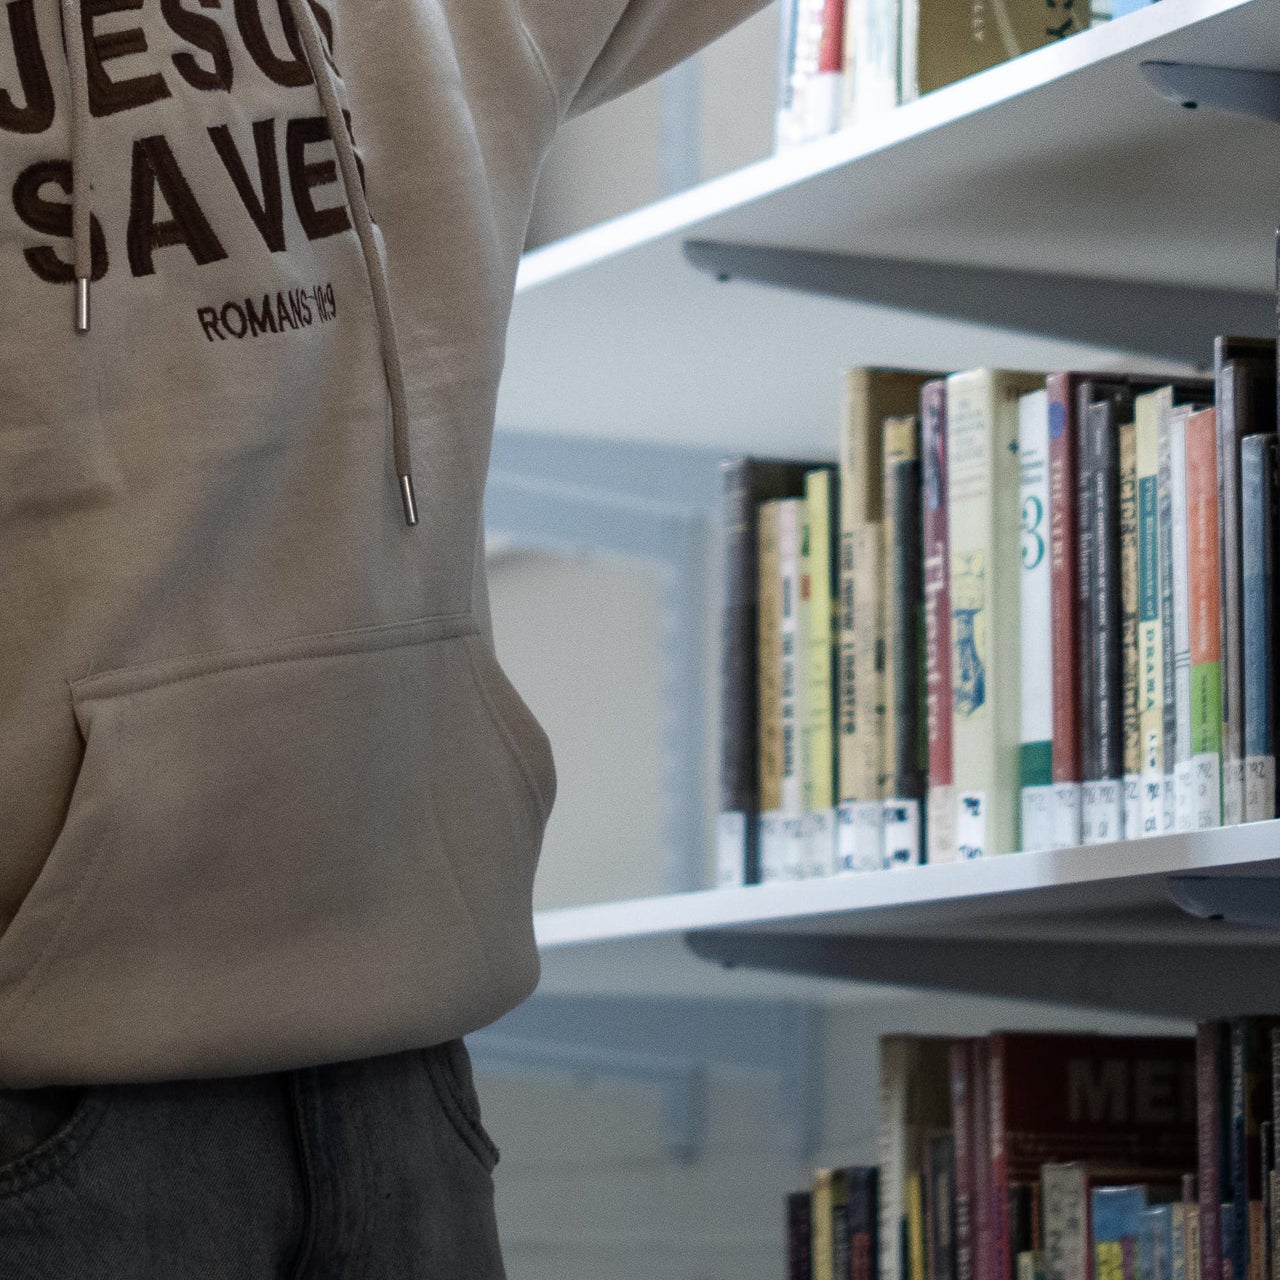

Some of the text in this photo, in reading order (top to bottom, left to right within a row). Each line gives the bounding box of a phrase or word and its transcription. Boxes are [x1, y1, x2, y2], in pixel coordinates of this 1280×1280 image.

[12, 108, 376, 283] SAVE
[197, 288, 313, 341] ROMANS
[1051, 457, 1064, 571] THEATRE
[1144, 627, 1159, 710] DRAMA
